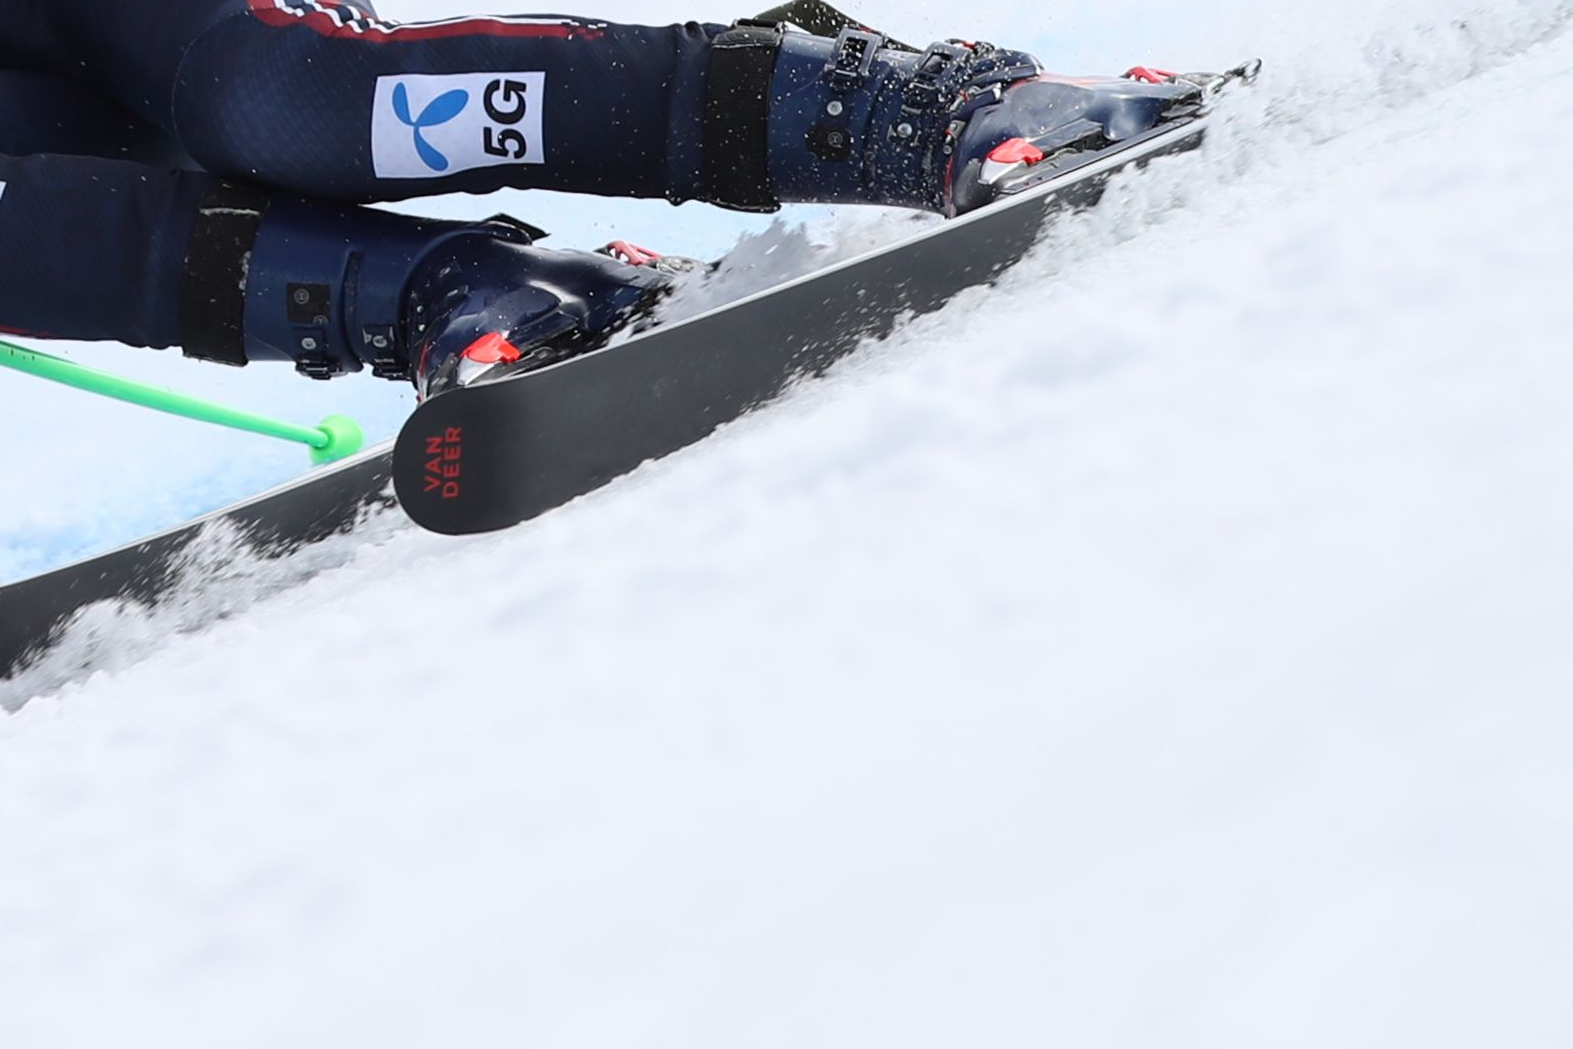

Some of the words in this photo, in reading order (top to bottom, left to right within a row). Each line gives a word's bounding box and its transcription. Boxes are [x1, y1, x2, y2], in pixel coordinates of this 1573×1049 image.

[483, 79, 527, 160] 5G
[423, 436, 444, 492] VAN
[441, 426, 463, 499] DEER
